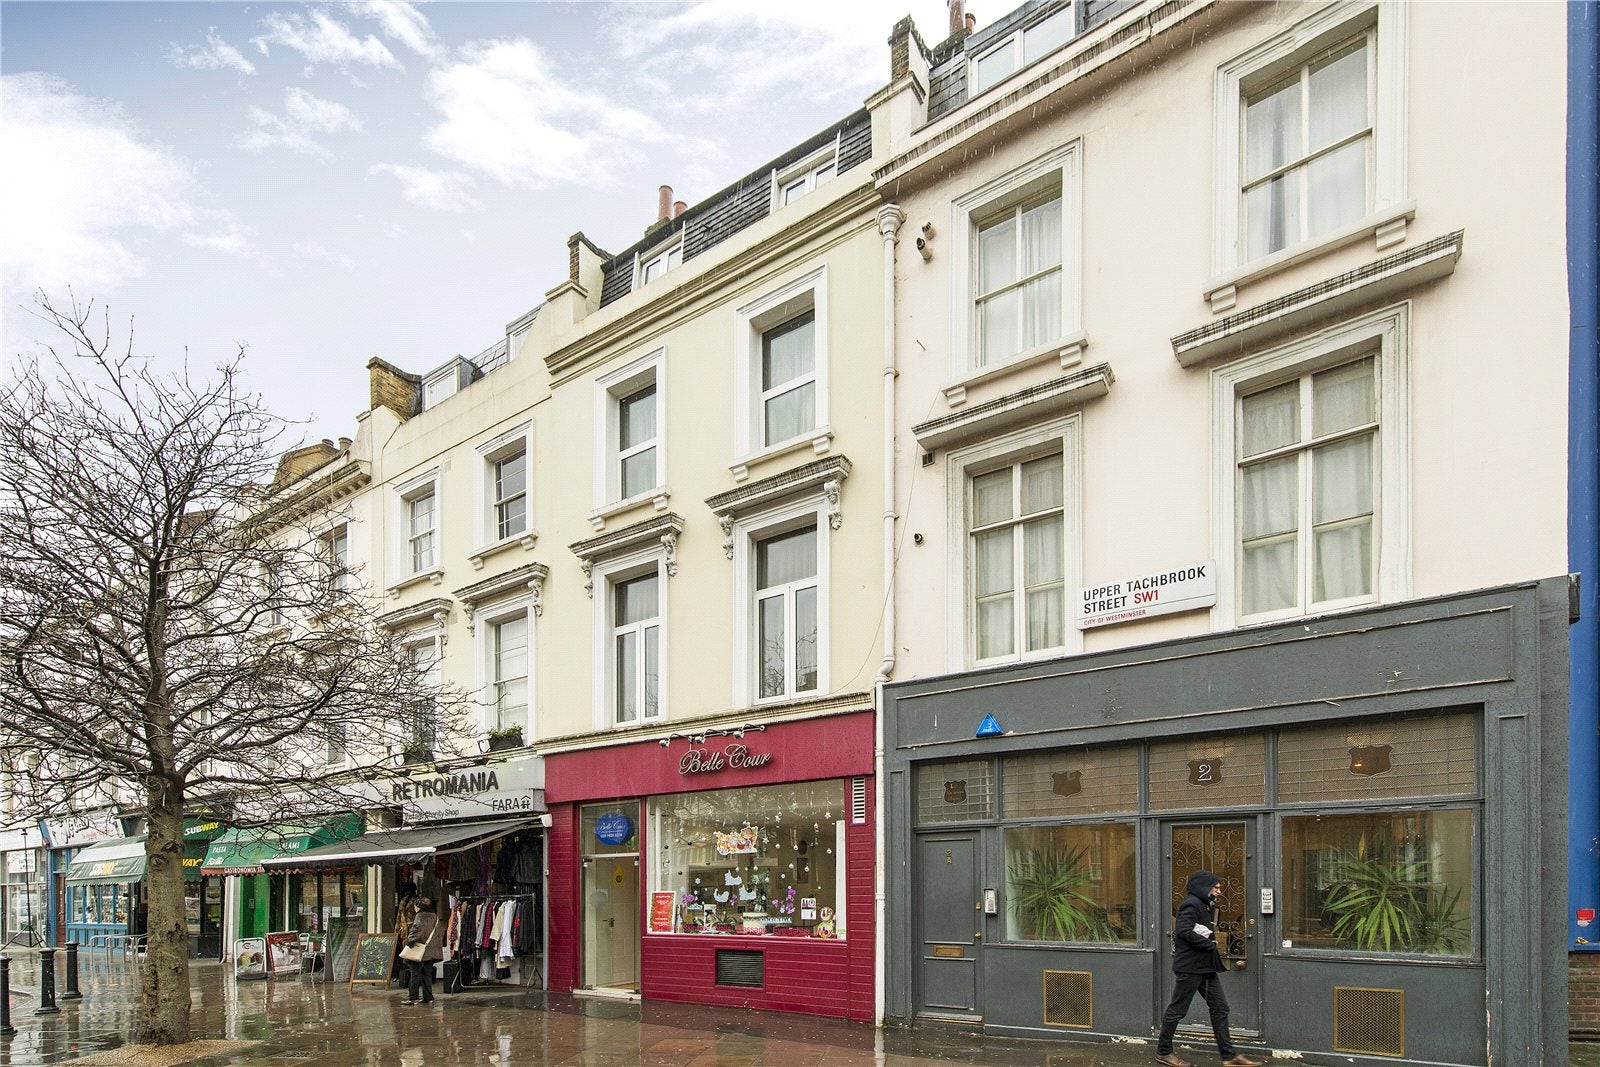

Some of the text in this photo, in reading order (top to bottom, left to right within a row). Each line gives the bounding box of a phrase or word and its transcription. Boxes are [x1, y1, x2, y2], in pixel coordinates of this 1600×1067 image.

[1084, 565, 1206, 601] UPPER TACHBROOK
[1084, 589, 1160, 614] STREET SW1
[1084, 609, 1147, 626] CITY OF WESTMINSTER
[679, 744, 771, 774] Belle Cour
[1197, 764, 1212, 781] 2
[392, 771, 499, 801] RETROMANIA
[444, 808, 460, 817] Shop
[492, 797, 520, 812] FARA
[183, 822, 219, 836] SUBWAY
[182, 858, 203, 867] WAY
